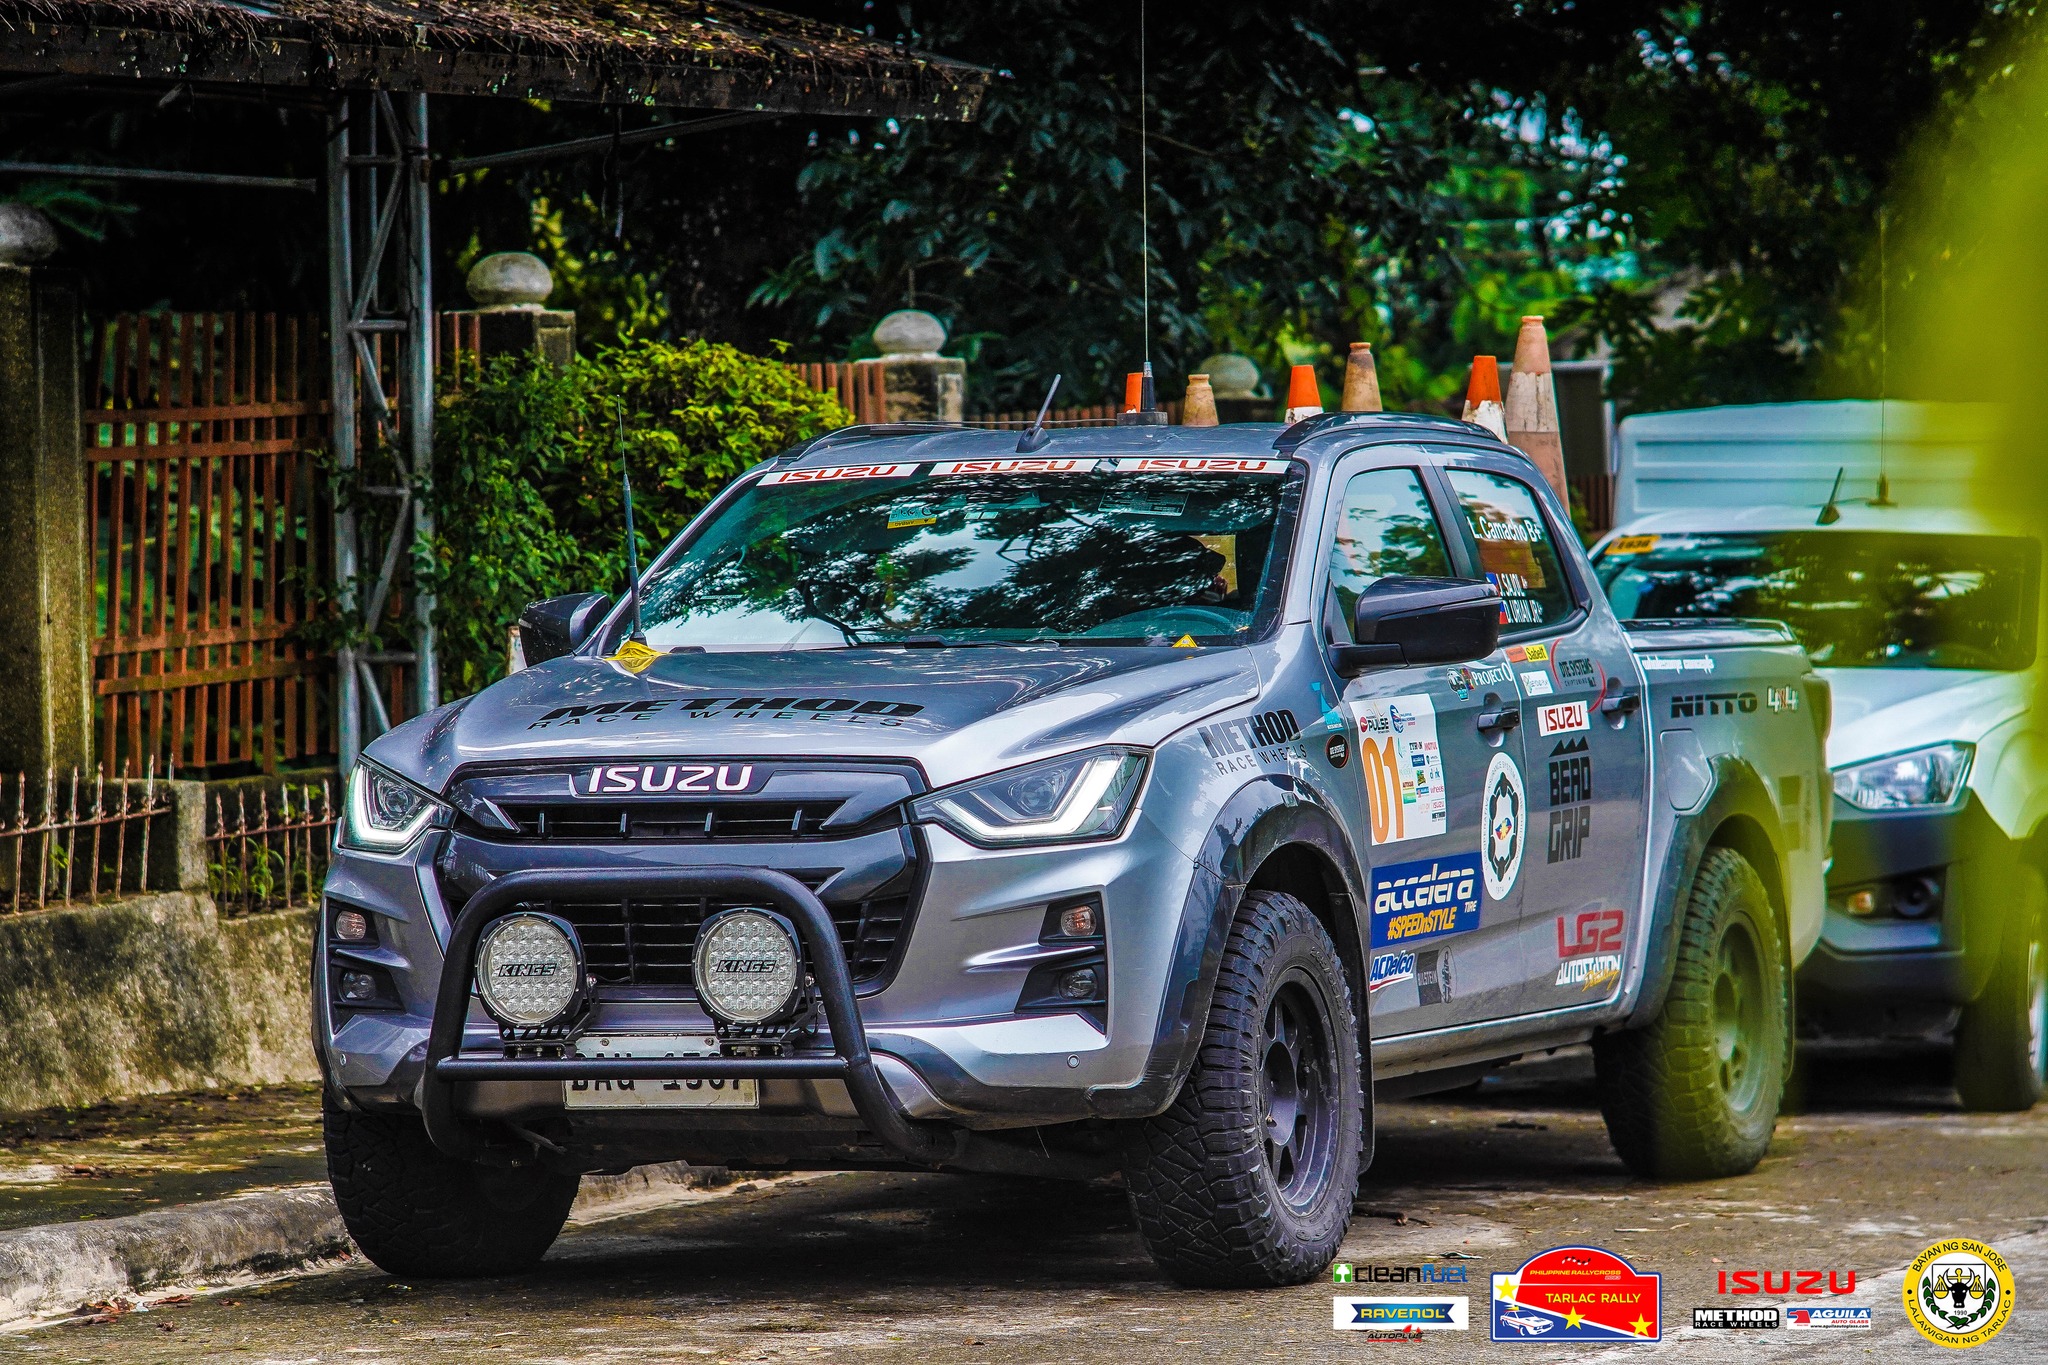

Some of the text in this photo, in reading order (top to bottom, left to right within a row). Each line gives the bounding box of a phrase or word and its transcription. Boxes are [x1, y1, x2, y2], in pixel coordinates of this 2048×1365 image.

[778, 465, 898, 482] ISUZU
[951, 460, 1078, 474] ISUZU
[1137, 459, 1268, 471] ISUZU
[1479, 516, 1528, 542] Camacho
[538, 697, 926, 720] METHOD
[1671, 691, 1758, 718] NITTO
[527, 710, 907, 730] RACE WHEELS
[1544, 704, 1583, 732] ISUZU
[1197, 709, 1302, 759] METHOD
[1216, 754, 1257, 775] RACE
[588, 765, 753, 793] ISUZU
[1362, 736, 1404, 843] 01
[1549, 756, 1591, 806] BEAD
[1547, 805, 1591, 864] GRIP
[1464, 901, 1478, 913] TIRE
[1557, 909, 1624, 958] LG2
[498, 963, 558, 977] KINGS
[716, 960, 777, 973] KINGS
[1370, 950, 1415, 981] ACDelco
